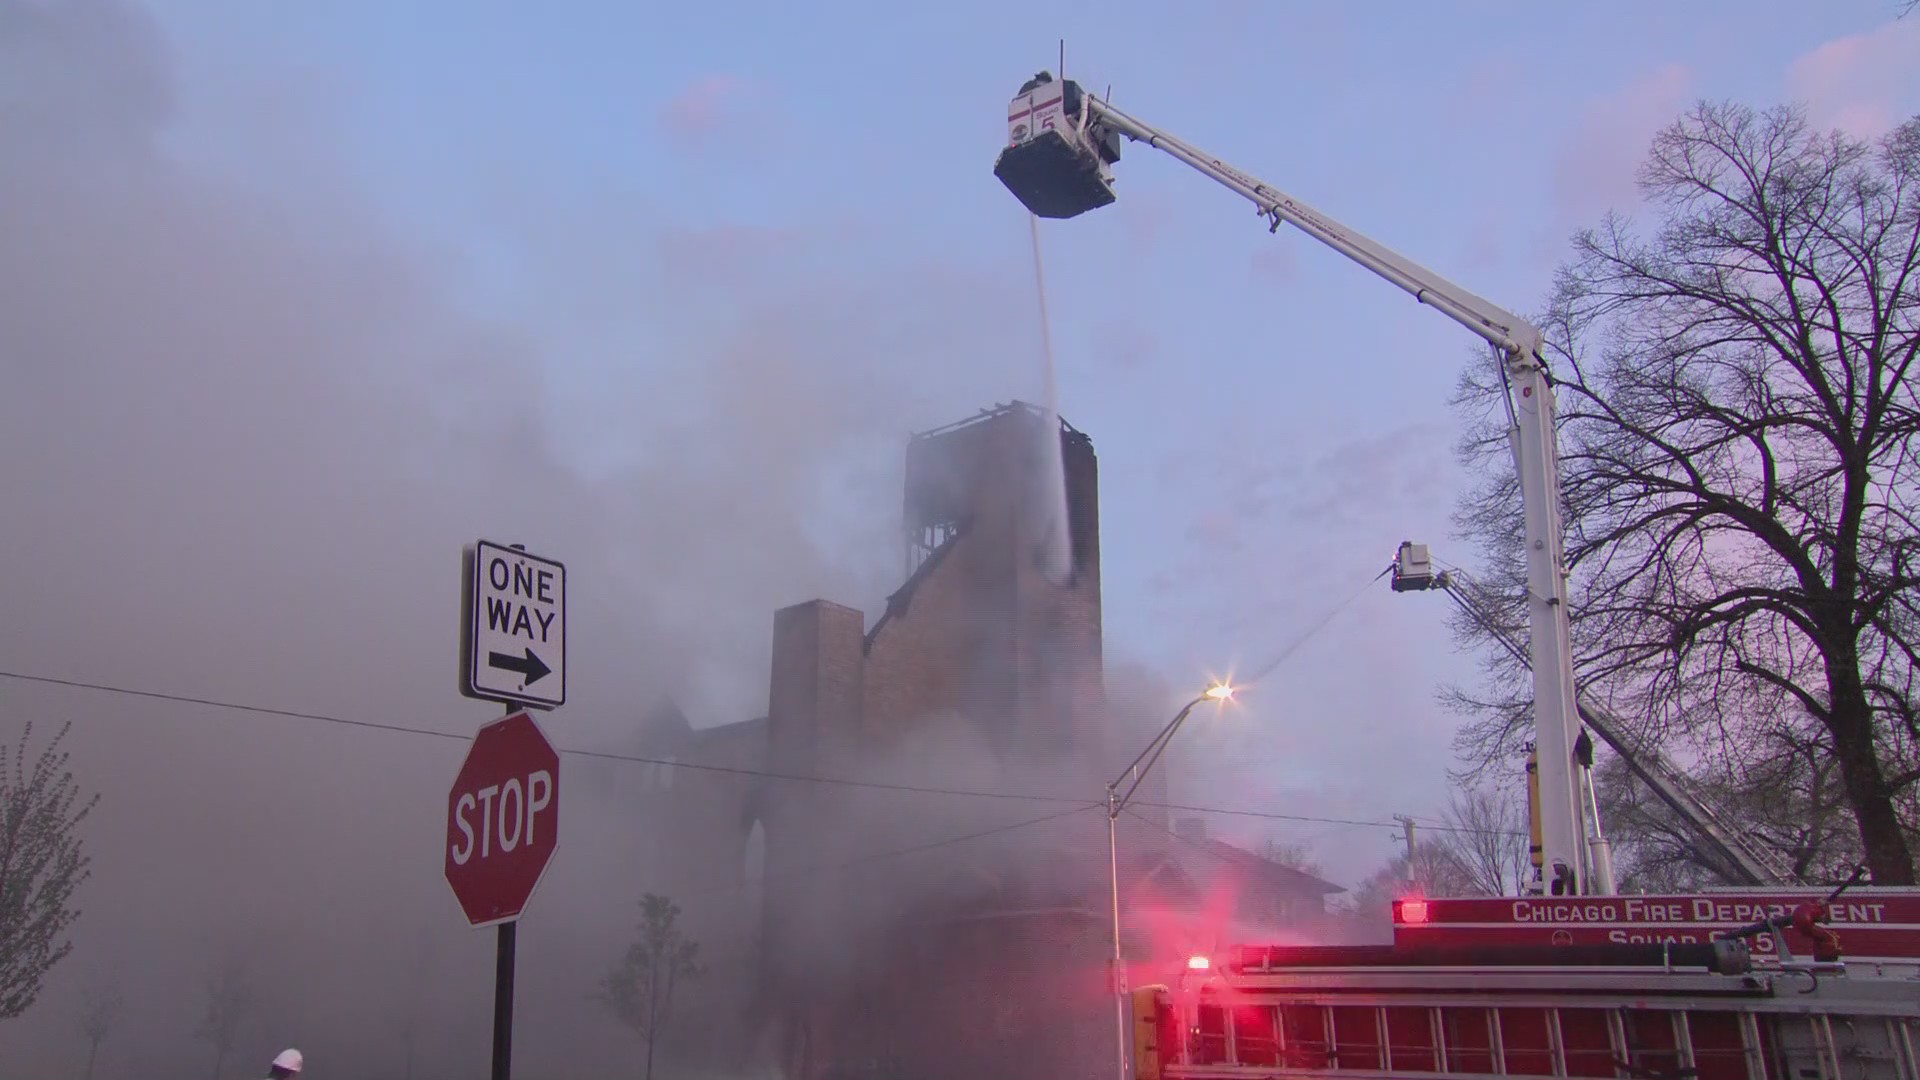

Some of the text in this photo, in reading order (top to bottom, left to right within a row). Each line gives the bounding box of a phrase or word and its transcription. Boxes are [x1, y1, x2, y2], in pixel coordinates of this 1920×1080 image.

[1042, 115, 1055, 129] 5
[490, 558, 554, 604] ONE
[488, 596, 555, 642] WAY
[452, 769, 552, 865] STOP
